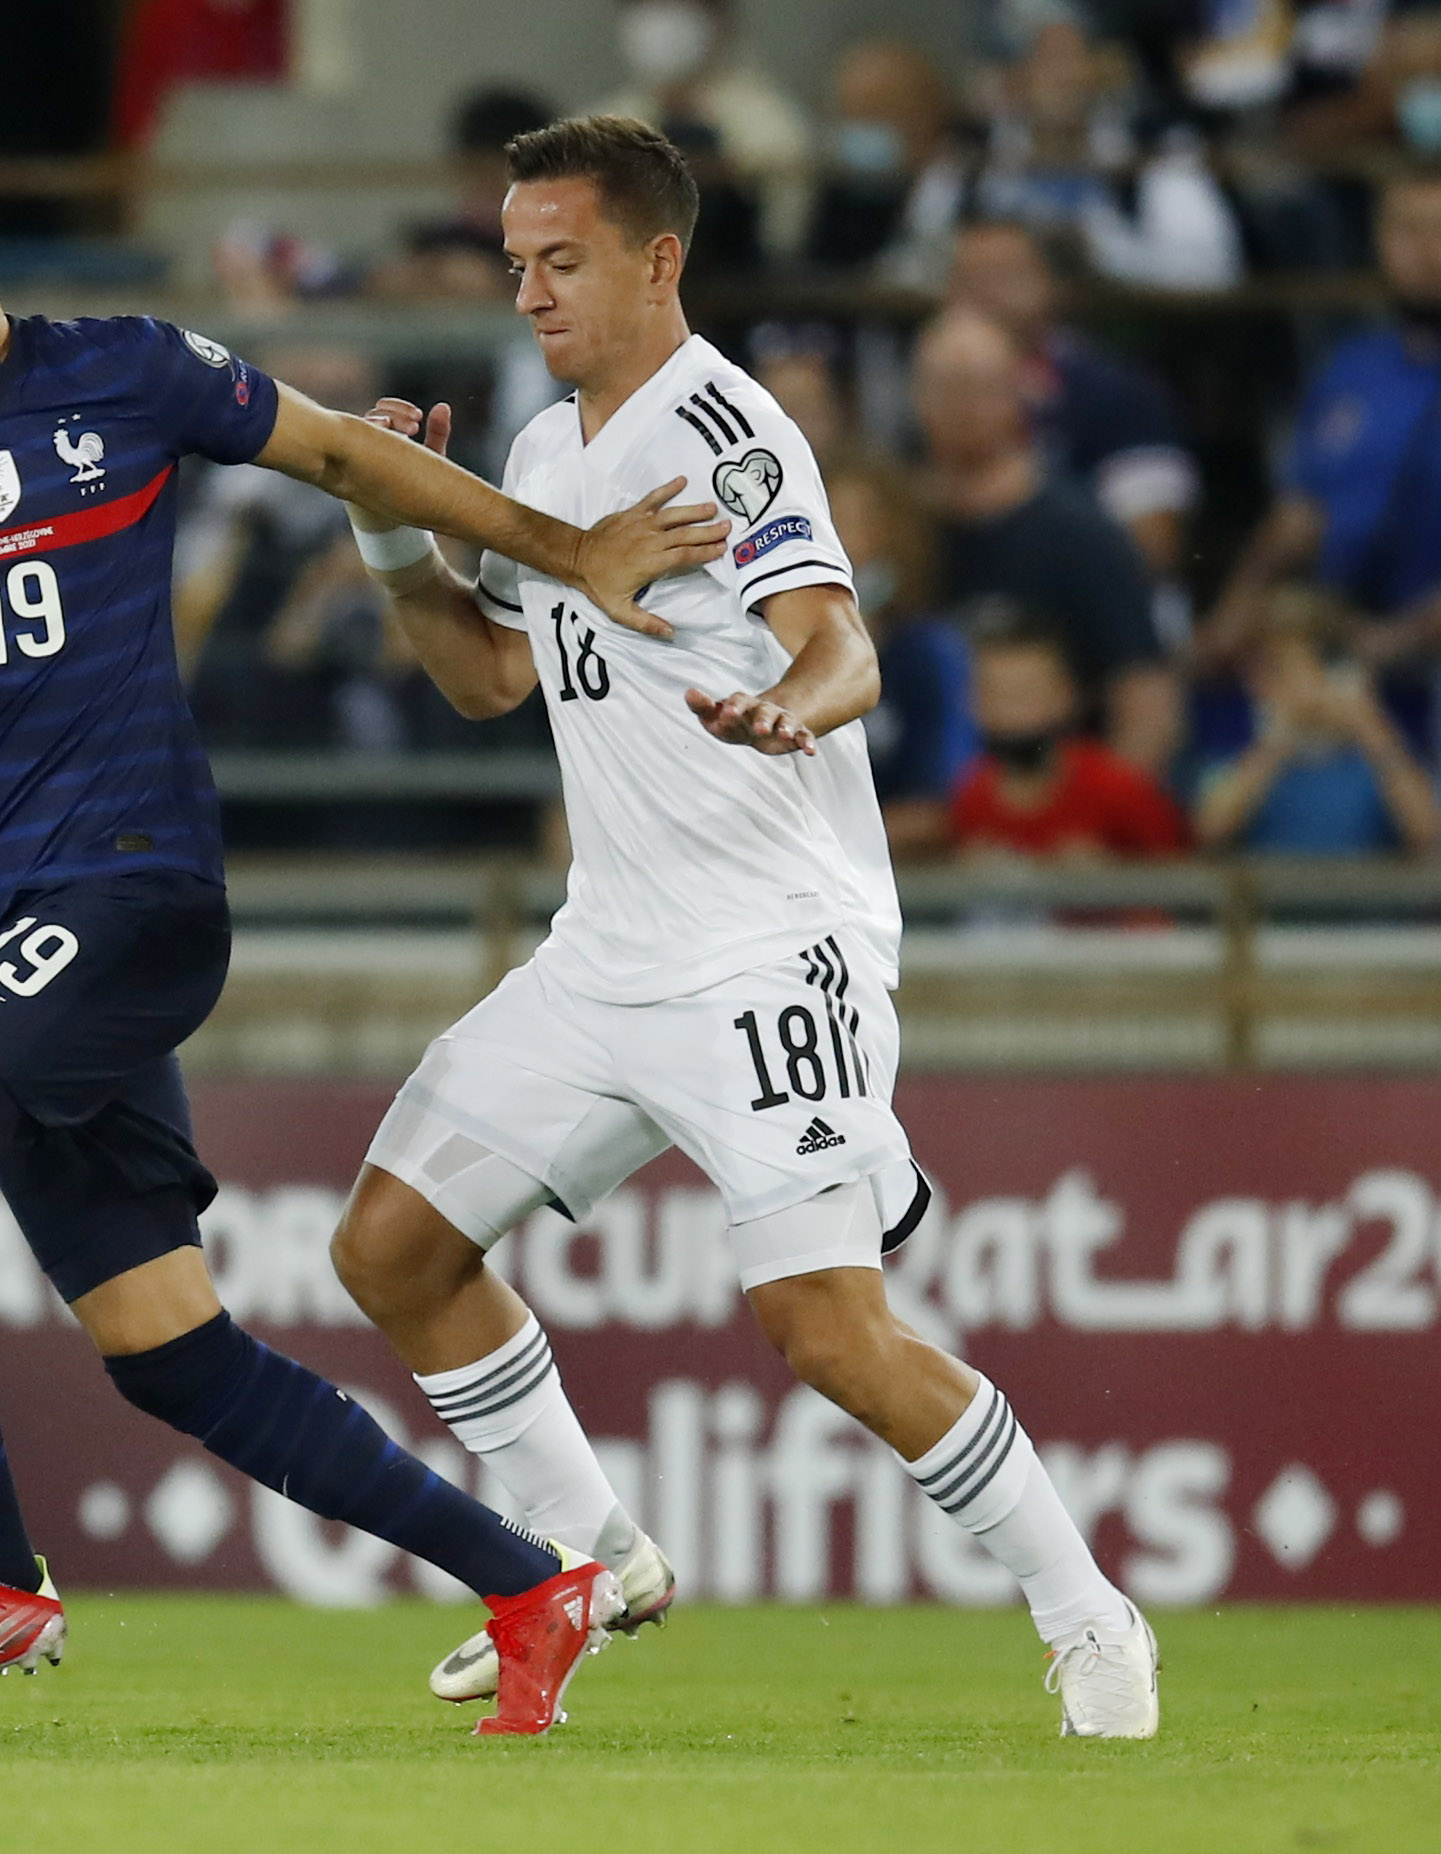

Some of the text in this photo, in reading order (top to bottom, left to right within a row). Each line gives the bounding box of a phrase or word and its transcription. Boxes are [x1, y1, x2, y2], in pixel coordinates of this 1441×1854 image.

[754, 520, 812, 551] RESPECT
[551, 602, 610, 702] 18
[734, 1005, 826, 1111] 18
[796, 1134, 846, 1155] adidas
[252, 1382, 1236, 1607] Qulifirs
